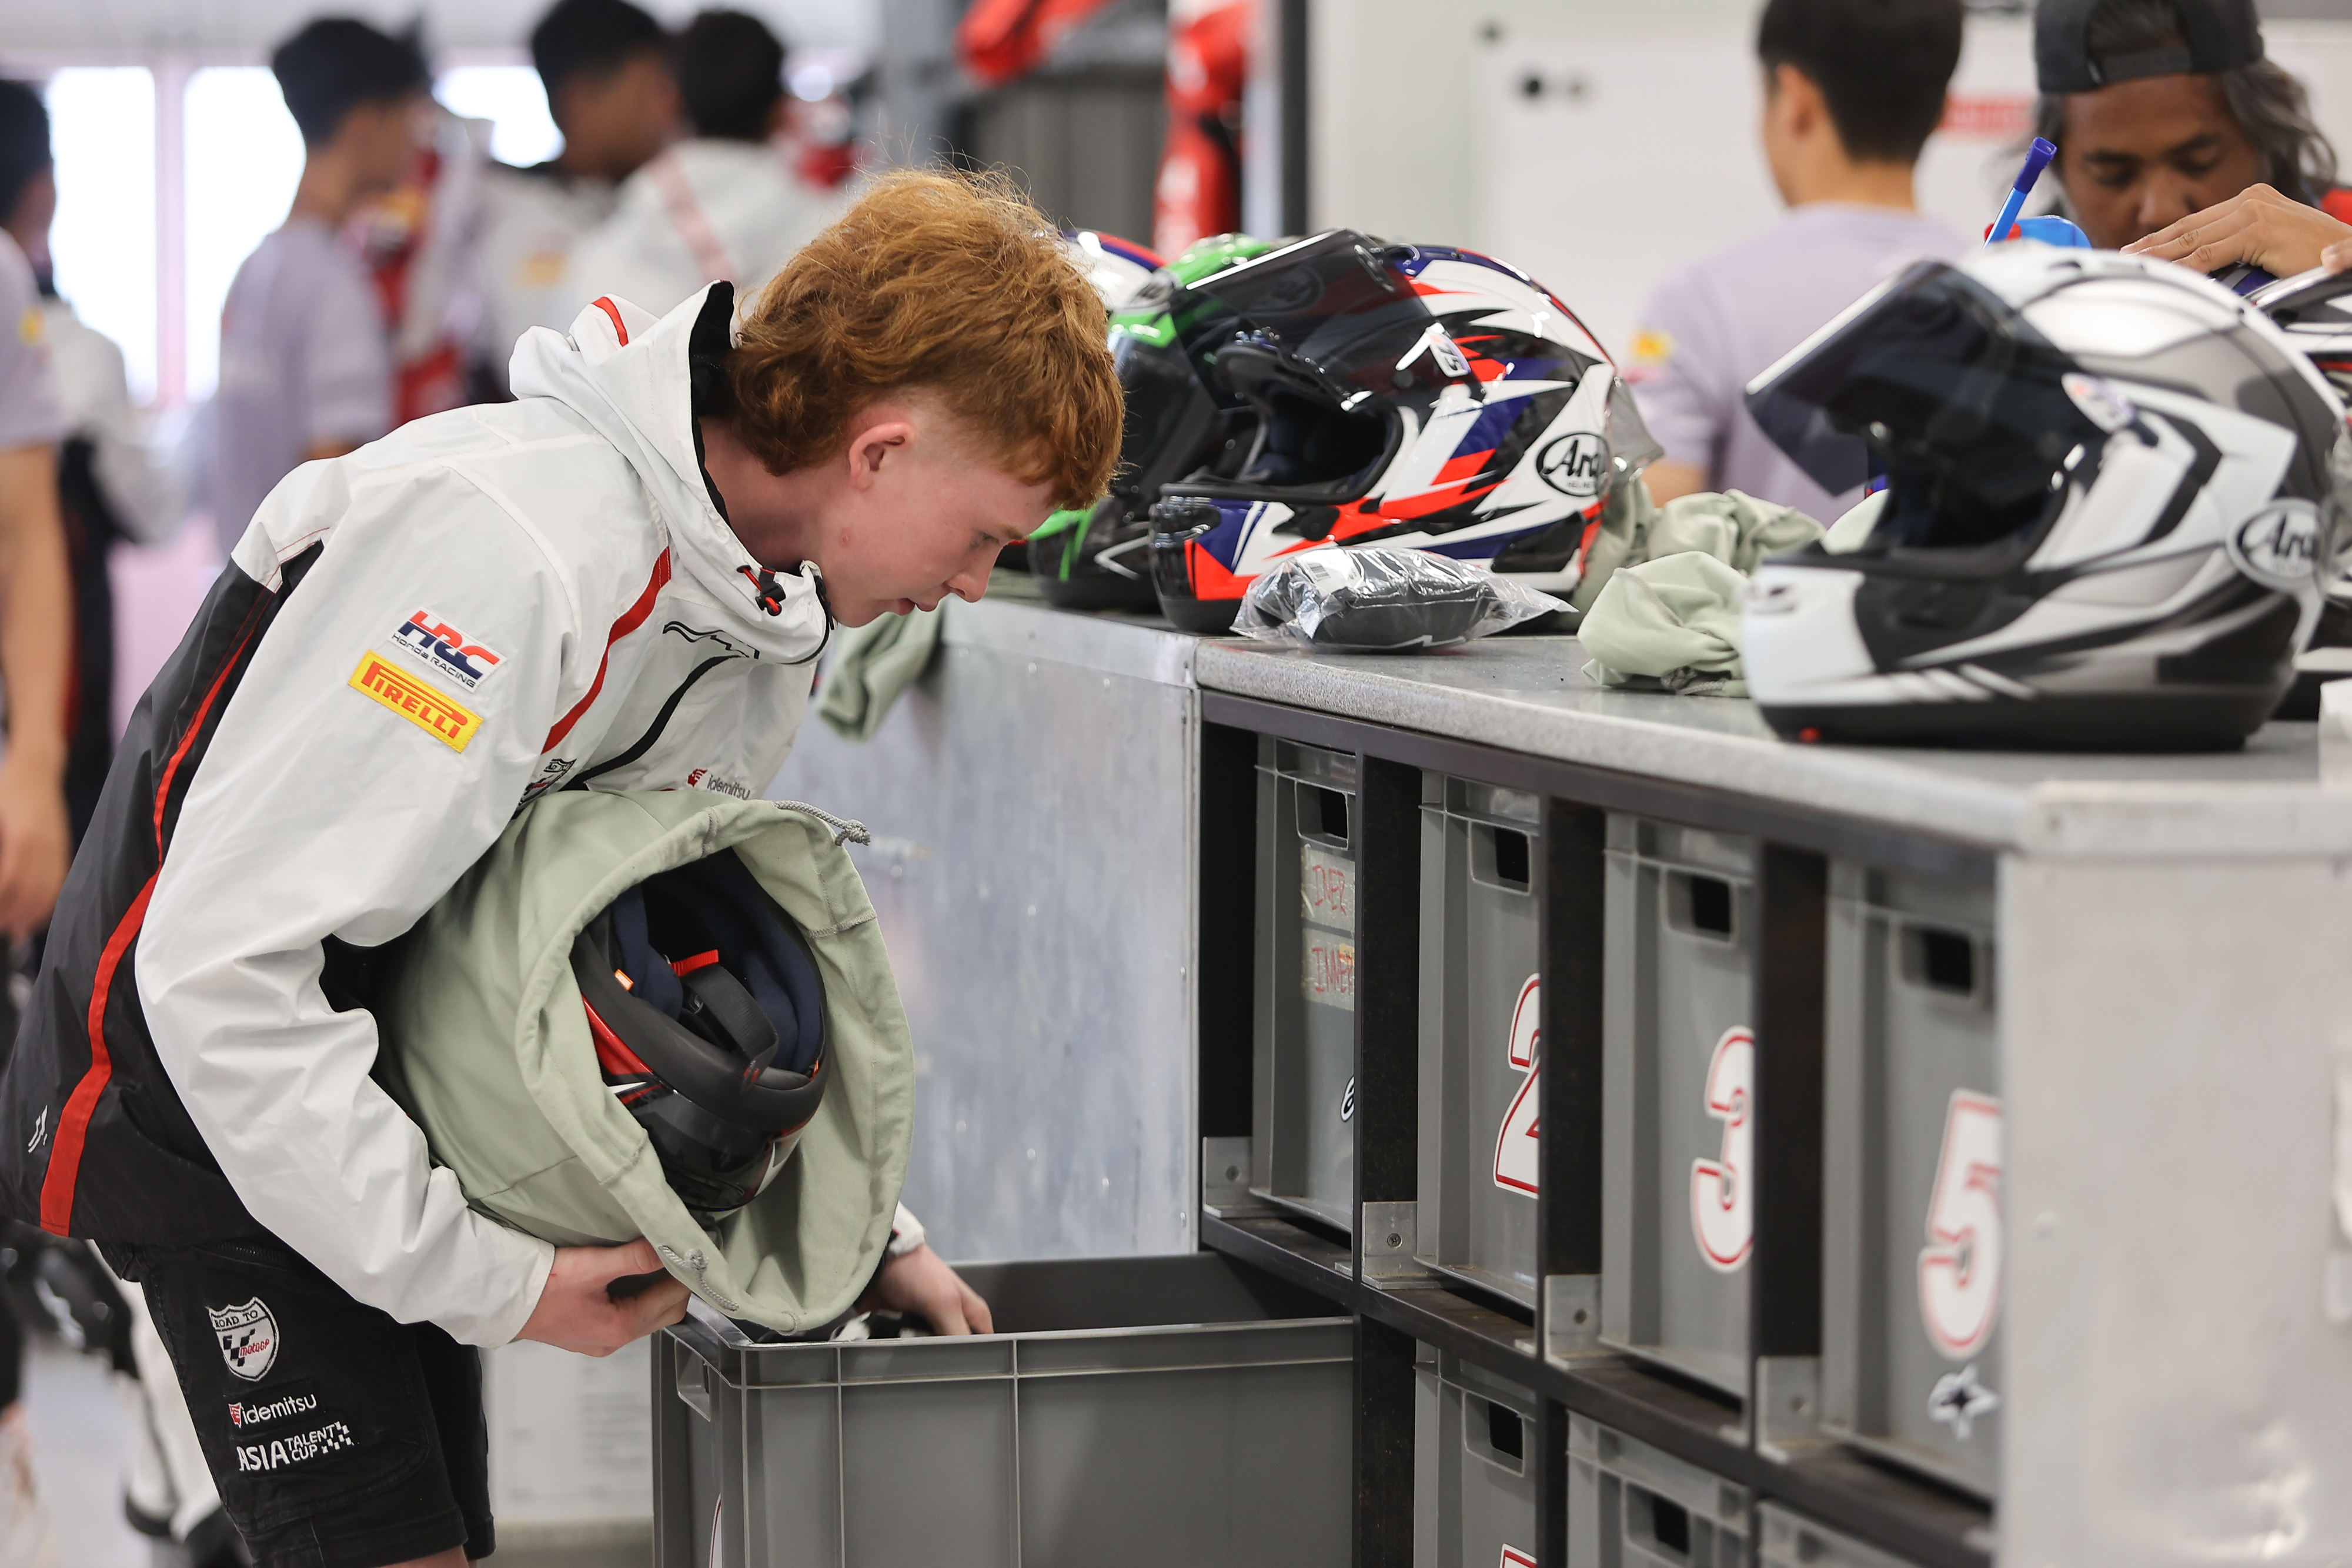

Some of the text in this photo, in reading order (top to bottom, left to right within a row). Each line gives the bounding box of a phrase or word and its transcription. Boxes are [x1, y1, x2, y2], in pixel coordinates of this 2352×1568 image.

[391, 633, 476, 689] Honda RACING
[397, 610, 502, 680] HRC
[360, 660, 469, 740] PIRELLI
[707, 774, 751, 801] idemitsu
[1690, 1025, 1754, 1273] 3
[1917, 1088, 2003, 1359] 5
[214, 1310, 258, 1328] ROAD TO
[241, 1393, 317, 1425] idemitsu
[236, 1424, 335, 1471] ASIA TALENT CUP
